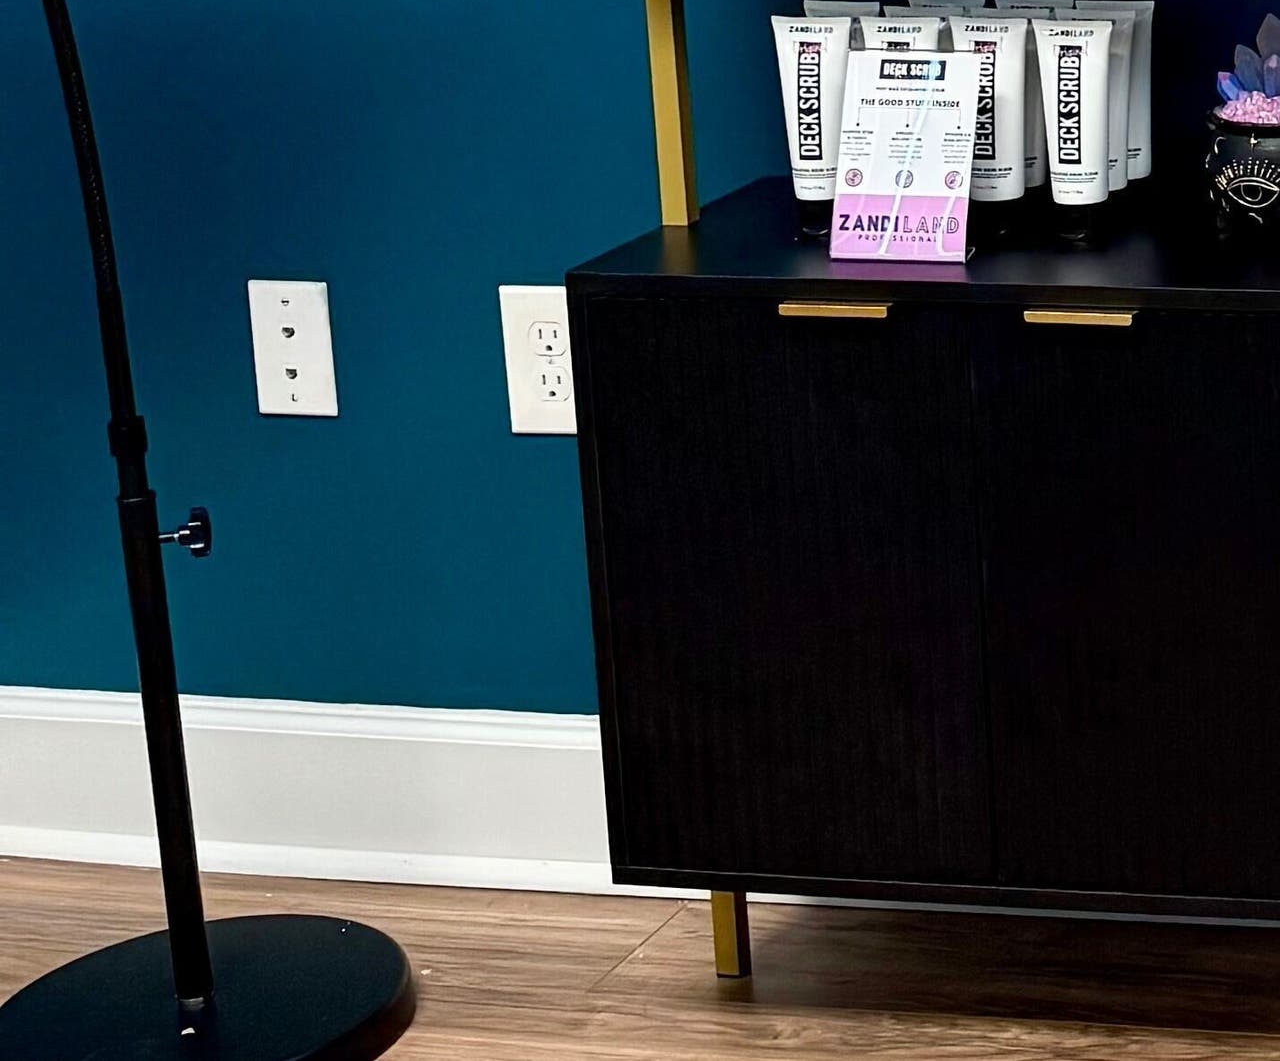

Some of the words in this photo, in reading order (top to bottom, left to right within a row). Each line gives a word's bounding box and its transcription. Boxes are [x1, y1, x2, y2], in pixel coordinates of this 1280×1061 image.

[799, 52, 819, 110] SCRUB
[883, 63, 908, 76] DECK
[910, 63, 941, 77] SCRUB
[1060, 56, 1079, 114] SCRUB
[861, 98, 875, 106] THE
[799, 112, 820, 156] DECK
[975, 112, 993, 156] DECK
[1060, 116, 1079, 160] DECK
